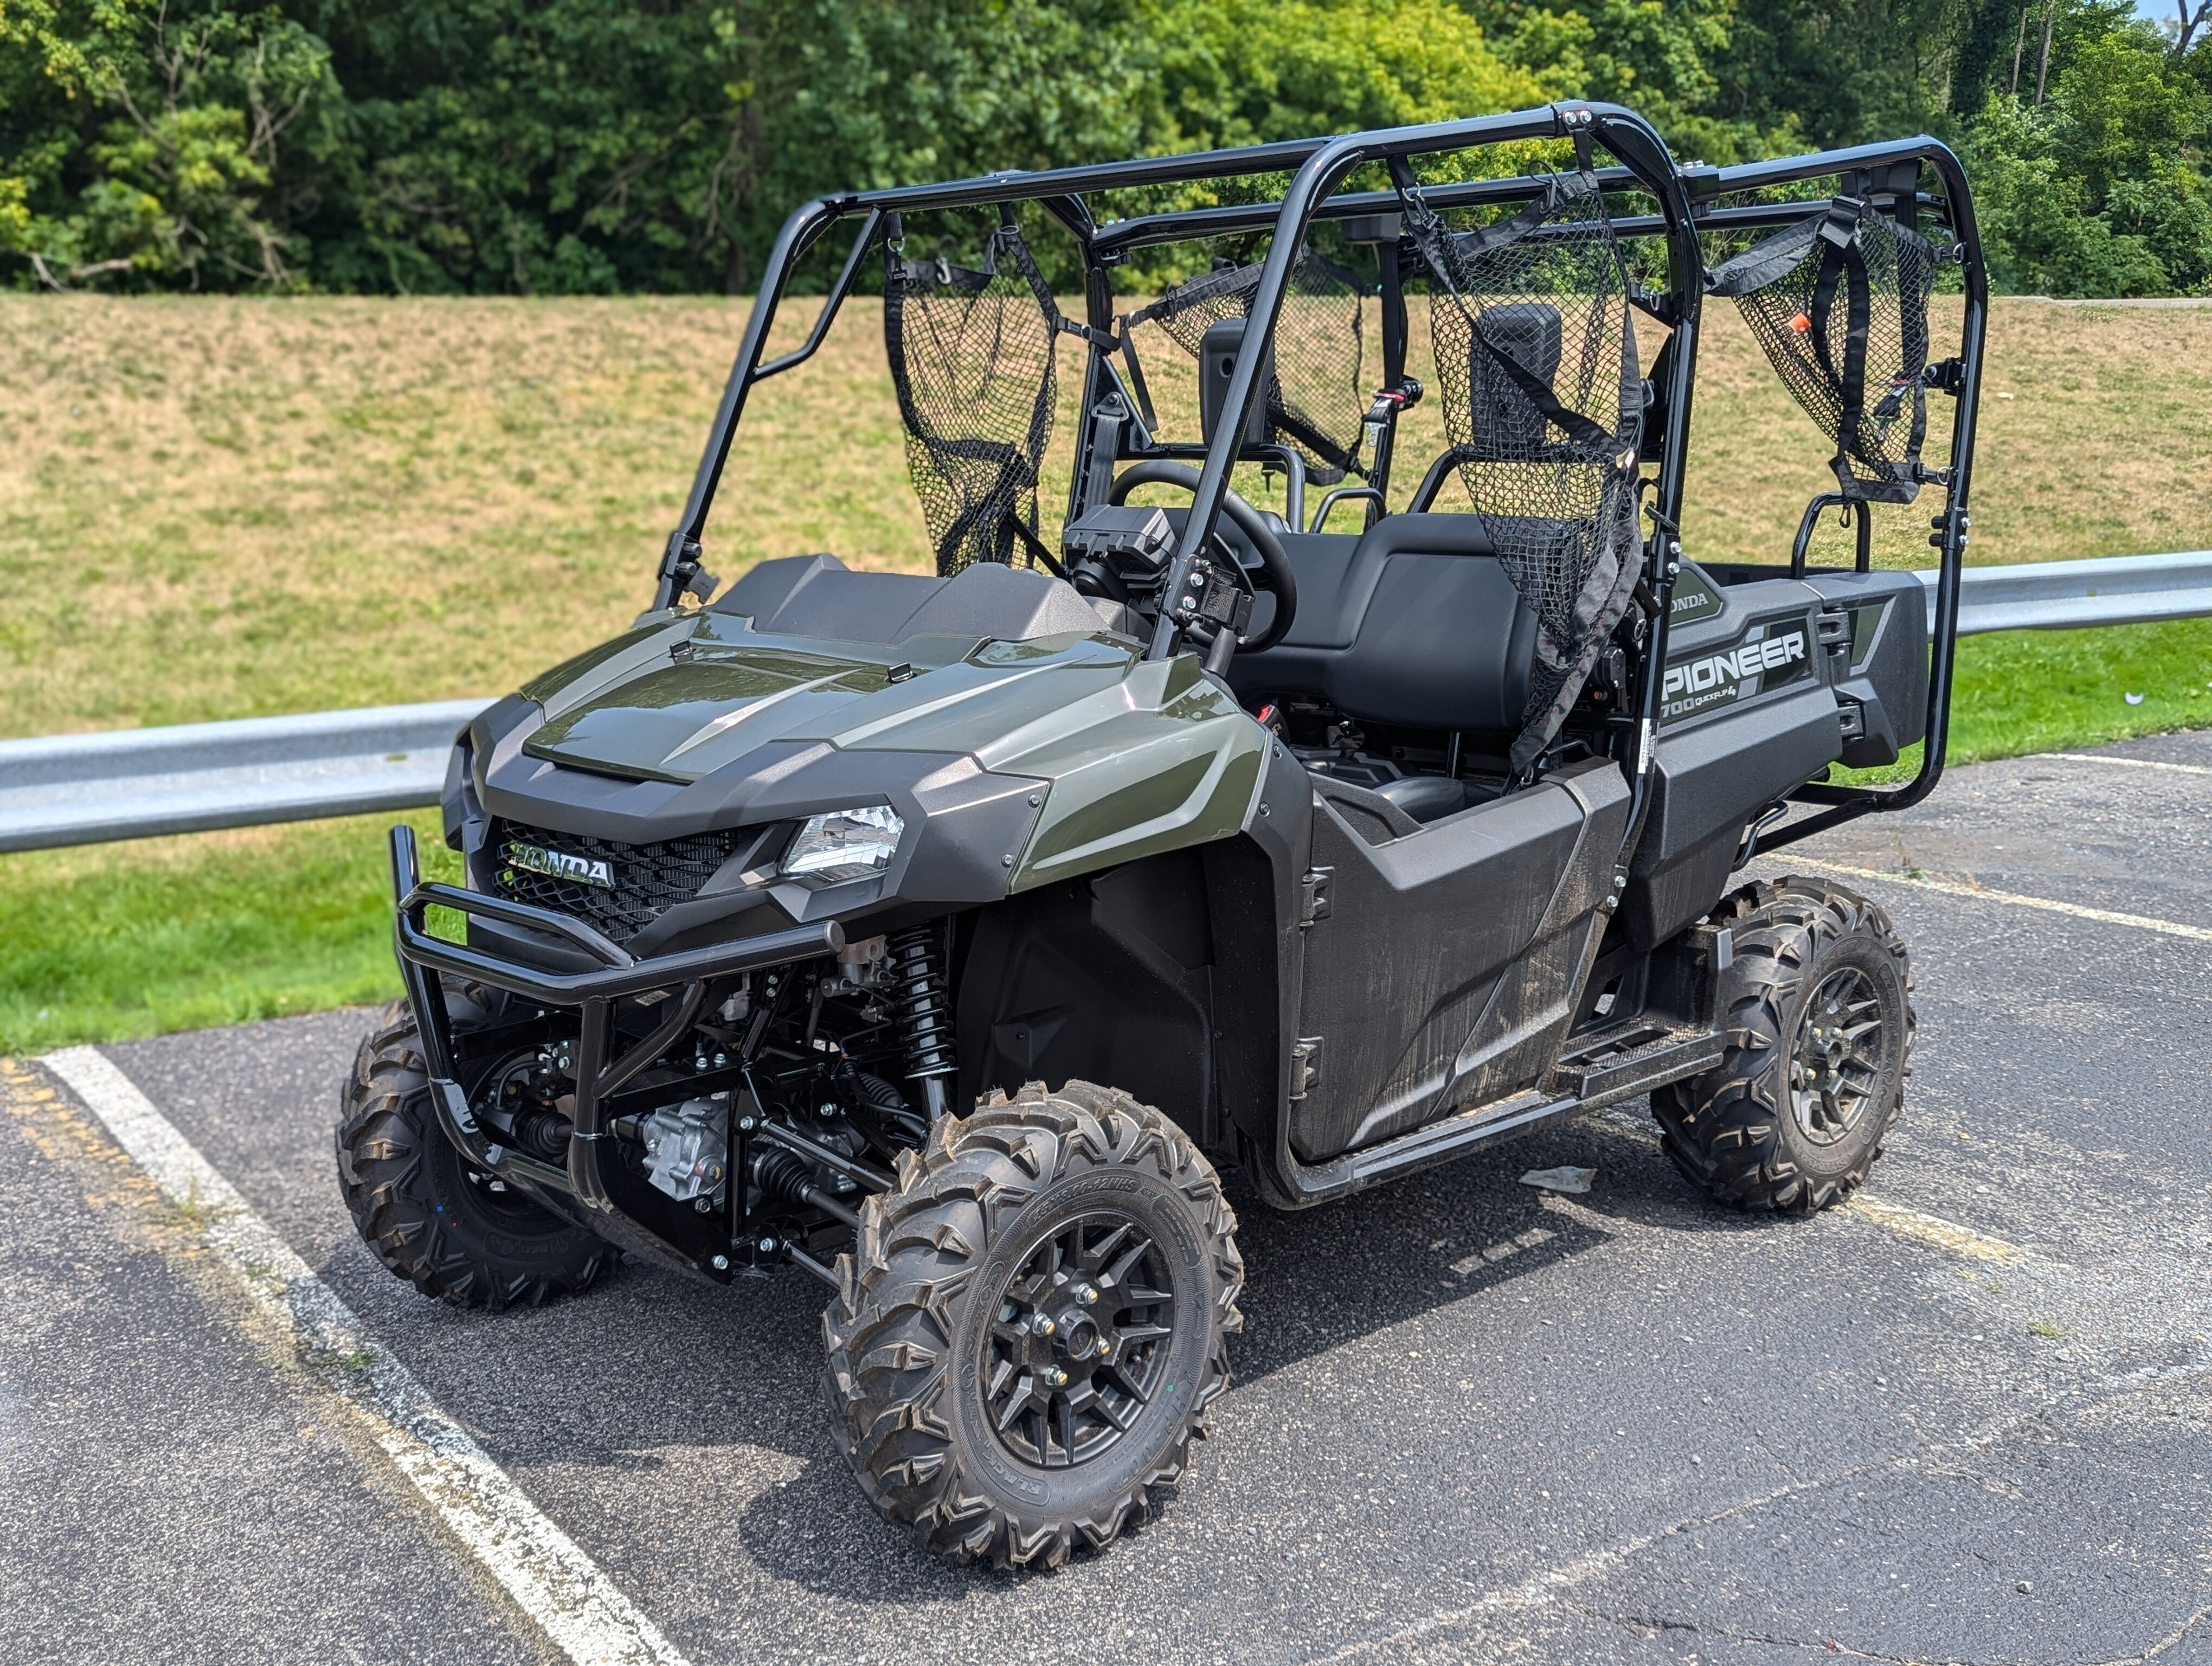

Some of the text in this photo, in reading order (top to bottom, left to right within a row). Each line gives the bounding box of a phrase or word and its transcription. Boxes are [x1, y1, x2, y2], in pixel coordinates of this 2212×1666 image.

[1670, 593, 1709, 613] ONDA
[1661, 631, 1805, 702] PIONEER
[513, 842, 612, 889] HONDA
